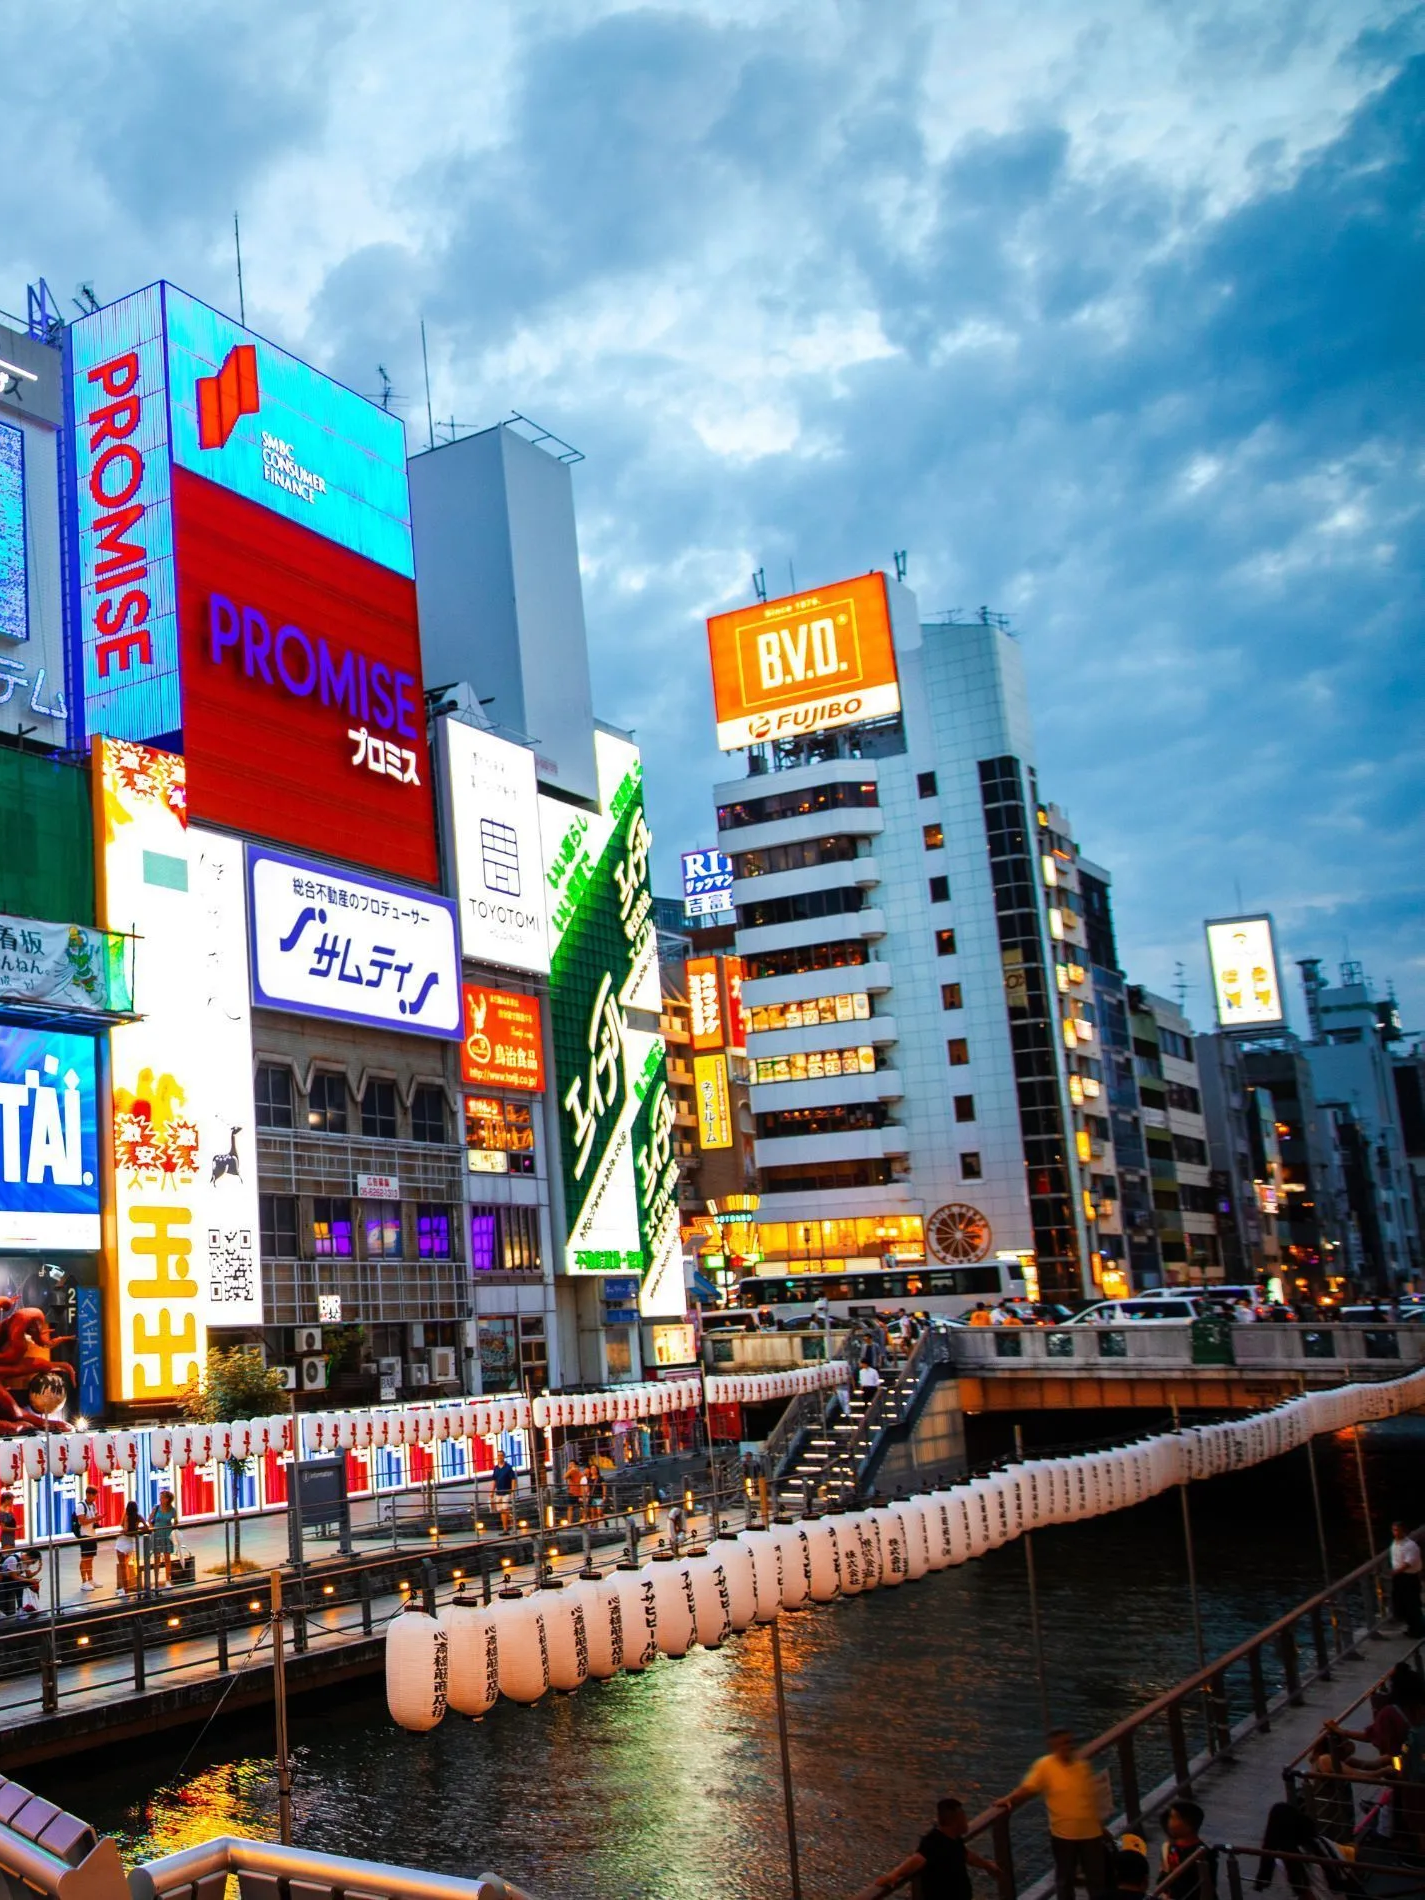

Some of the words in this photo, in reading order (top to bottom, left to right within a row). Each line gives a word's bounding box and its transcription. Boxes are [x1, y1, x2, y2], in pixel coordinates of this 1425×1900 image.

[261, 430, 295, 462] SMBC
[262, 450, 327, 496] CONSUMER
[88, 351, 154, 679] PROMISE
[264, 465, 316, 505] FINANCE
[208, 592, 418, 740] PROMISE
[757, 617, 849, 690] B.V.D.
[777, 697, 863, 730] FUJIBO
[347, 727, 422, 787] プロミス
[613, 805, 654, 922] エイブル
[292, 876, 431, 925] 総合不動産のプロデューサー
[469, 898, 541, 932] TOYOTOMI
[308, 931, 415, 994] サムティ
[700, 972, 721, 1034] カラオケ
[565, 971, 628, 1182] エイブル
[701, 1081, 718, 1143] ネットルーム
[127, 1205, 199, 1400] 玉出
[432, 1630, 449, 1719] 心斎橋筋商店街
